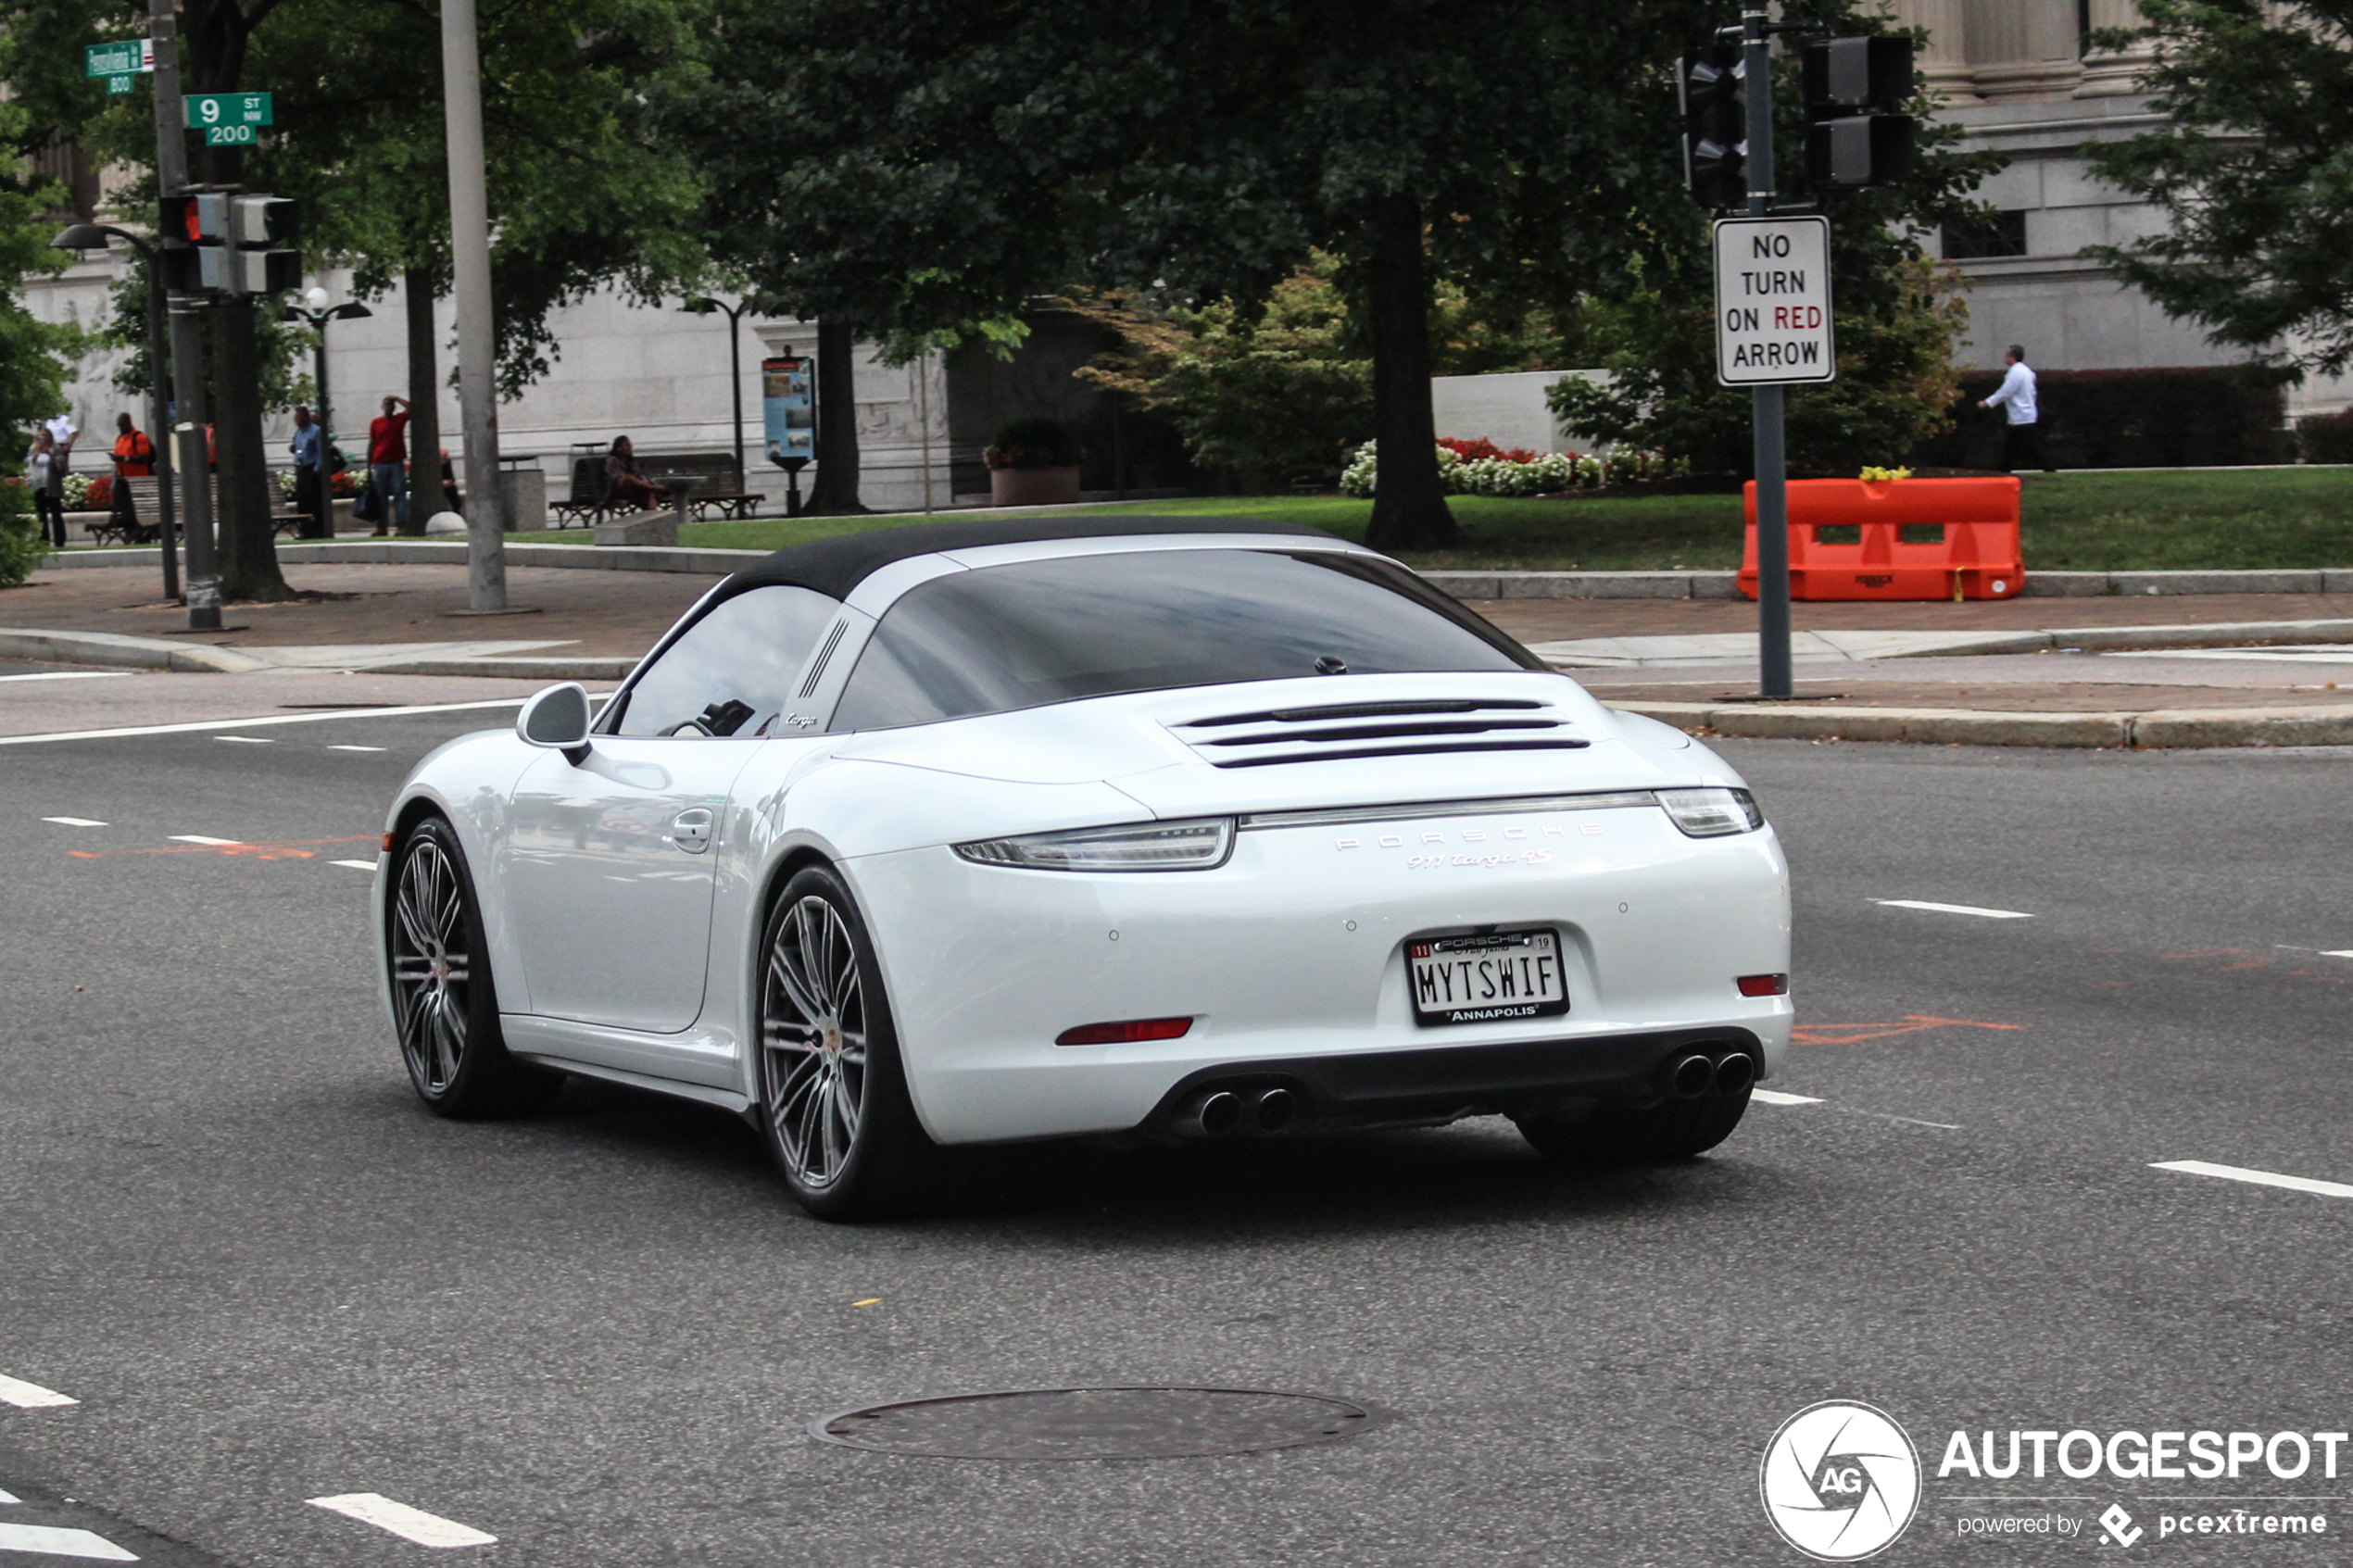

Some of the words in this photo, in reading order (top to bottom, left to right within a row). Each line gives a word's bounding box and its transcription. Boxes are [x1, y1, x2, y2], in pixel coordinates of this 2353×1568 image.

[200, 98, 220, 123] 9
[244, 97, 260, 109] ST
[244, 110, 262, 122] NW
[210, 124, 250, 144] 200
[1754, 234, 1791, 258] NO
[1742, 270, 1805, 295] TURN
[1727, 307, 1758, 332] ON
[1774, 306, 1822, 330] RED
[1733, 341, 1818, 367] ARROW
[1335, 822, 1604, 851] PORSCHE
[1407, 853, 1446, 869] 911
[1521, 847, 1553, 866] 4S
[1416, 946, 1428, 957] 11
[1441, 935, 1523, 947] PORSCHE
[1538, 936, 1550, 947] 19
[1417, 956, 1554, 1004] MYTSWIF
[1452, 1005, 1537, 1022] ANNAPOLIS
